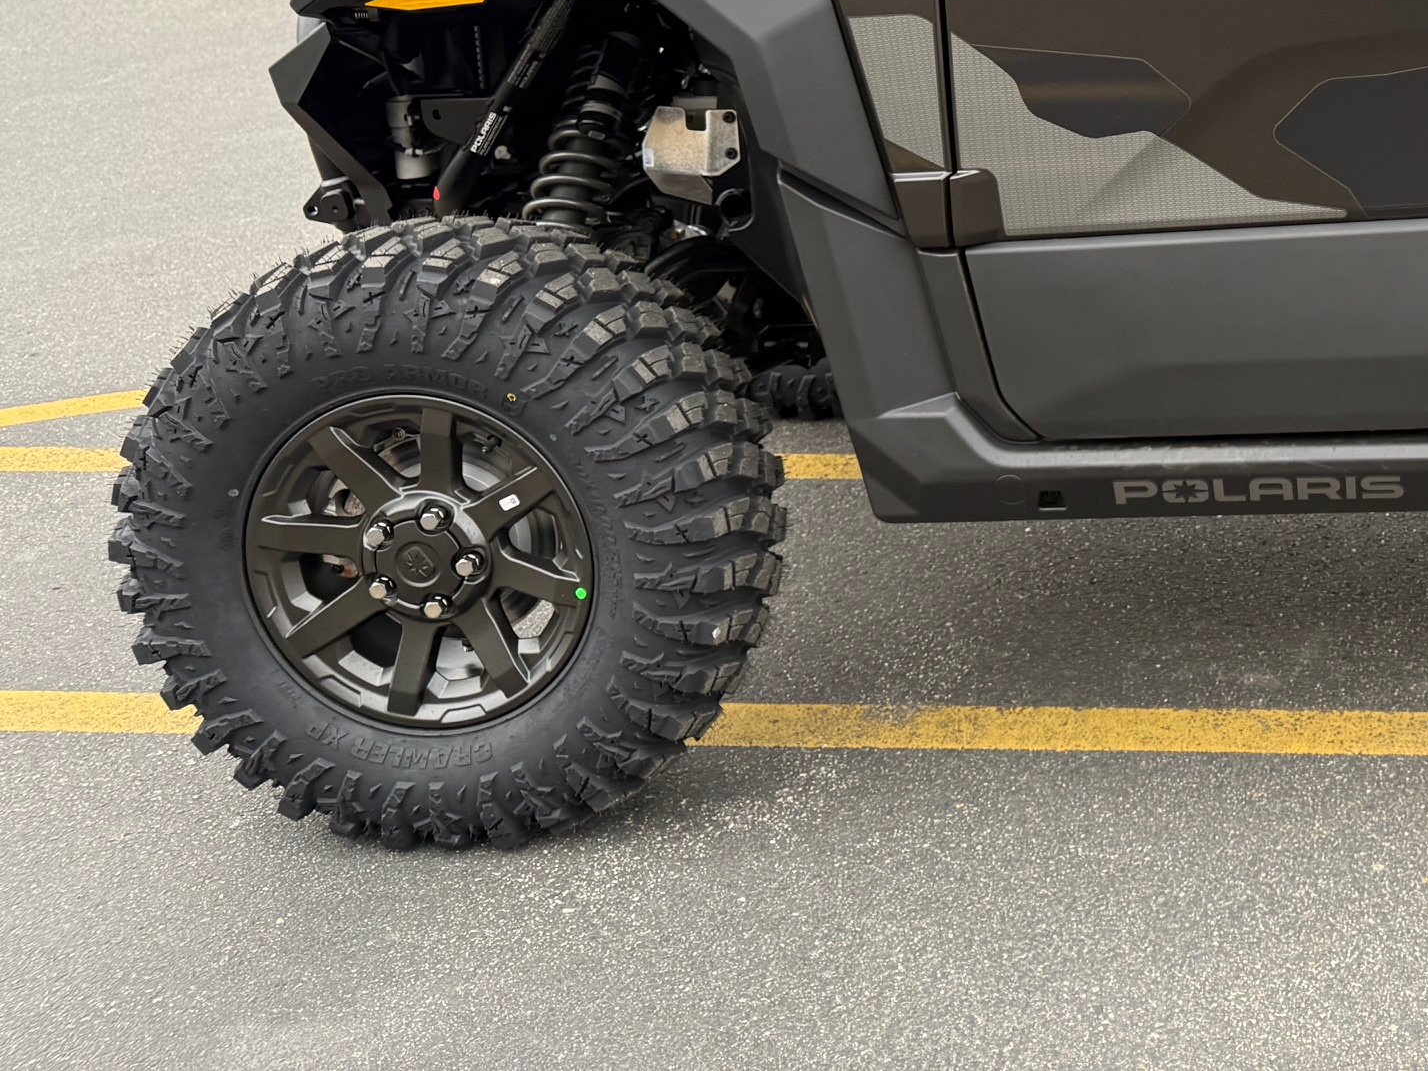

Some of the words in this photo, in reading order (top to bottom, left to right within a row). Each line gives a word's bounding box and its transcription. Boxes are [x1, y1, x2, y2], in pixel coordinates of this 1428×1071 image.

[470, 112, 497, 153] POLARIS
[1112, 476, 1405, 505] POLARIS
[303, 720, 349, 751] XP
[350, 737, 492, 770] CRAWLER
